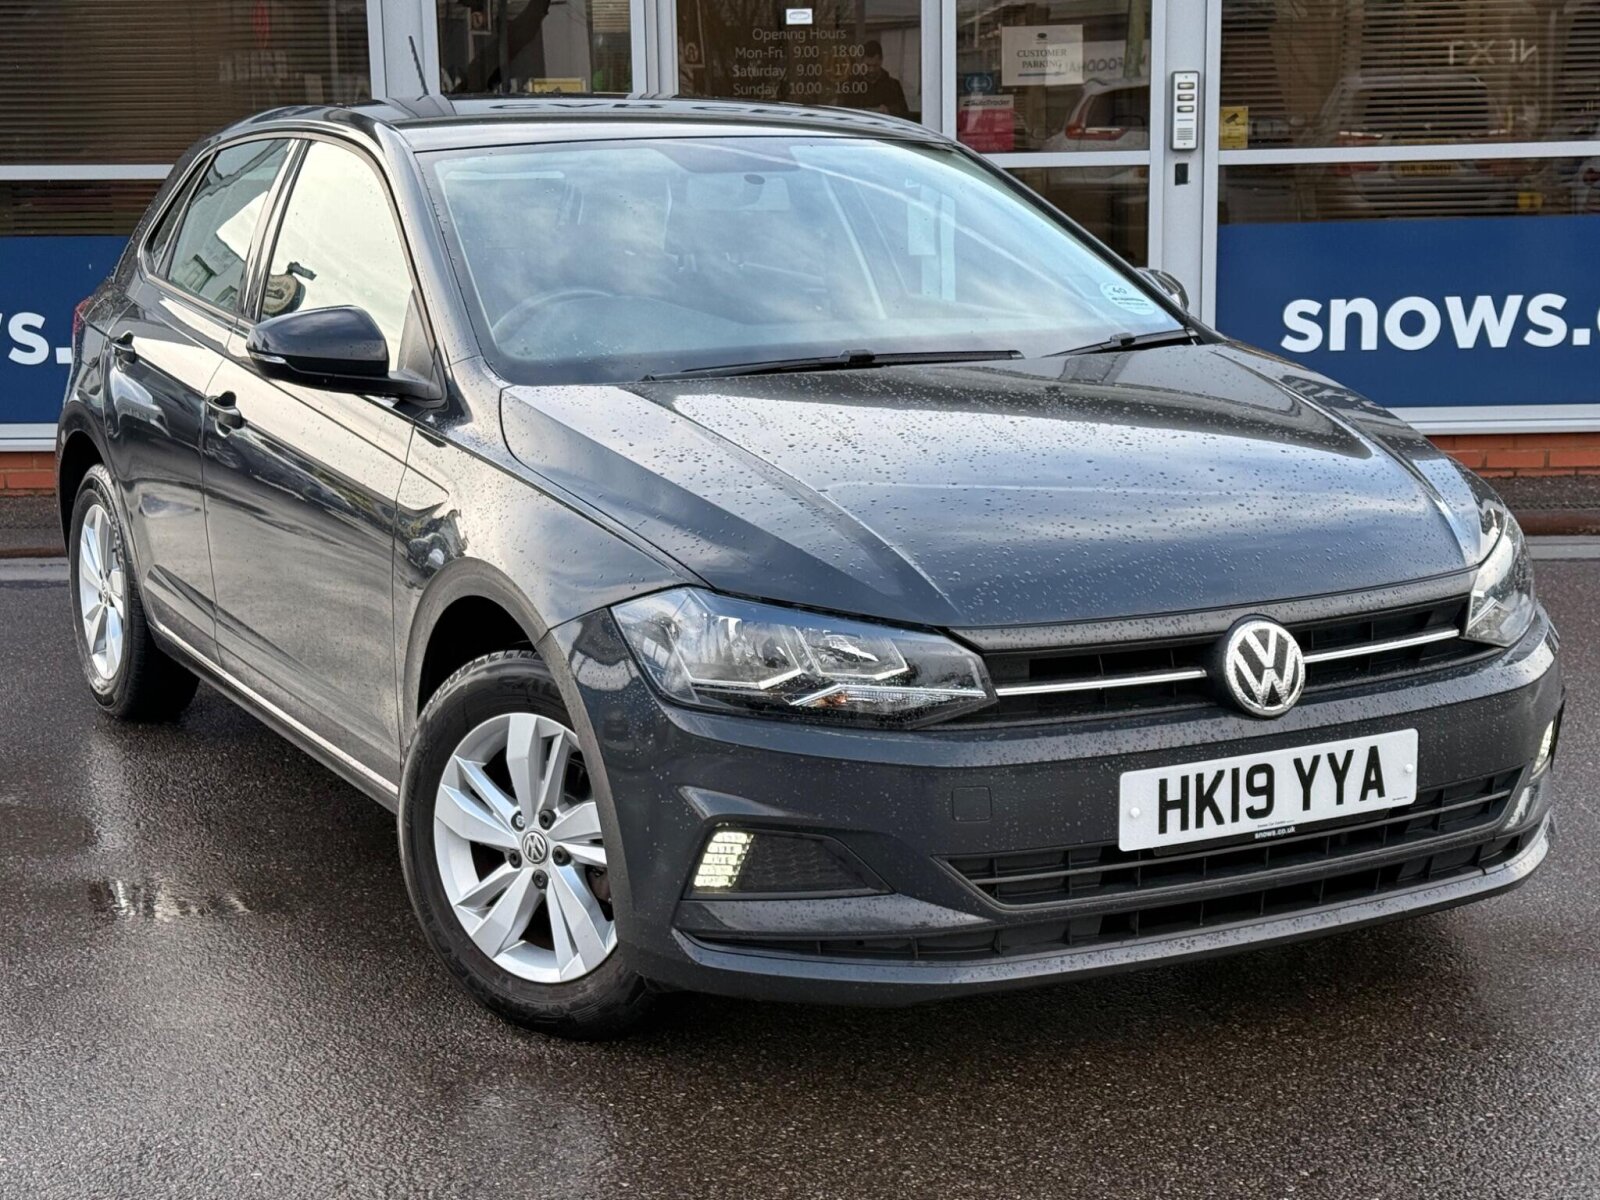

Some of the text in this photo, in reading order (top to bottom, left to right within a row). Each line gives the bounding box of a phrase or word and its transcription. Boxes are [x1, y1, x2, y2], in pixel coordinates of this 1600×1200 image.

[752, 28, 847, 43] Opening Hours
[734, 46, 783, 59] Mon-Fri
[793, 46, 819, 58] 9.00
[832, 44, 865, 57] 18.00
[1017, 48, 1067, 58] CUSTOMER
[732, 64, 787, 79] Saturday
[797, 63, 823, 76] 9.00
[836, 62, 868, 76] 17.00
[1022, 59, 1061, 69] PARKING
[733, 82, 779, 97] Sunday
[790, 82, 822, 95] 10.00
[836, 81, 868, 94] 16.00
[1280, 293, 1600, 354] snows.
[1158, 745, 1386, 835] HK19 YYA
[1254, 825, 1296, 840] snows.co.uk
